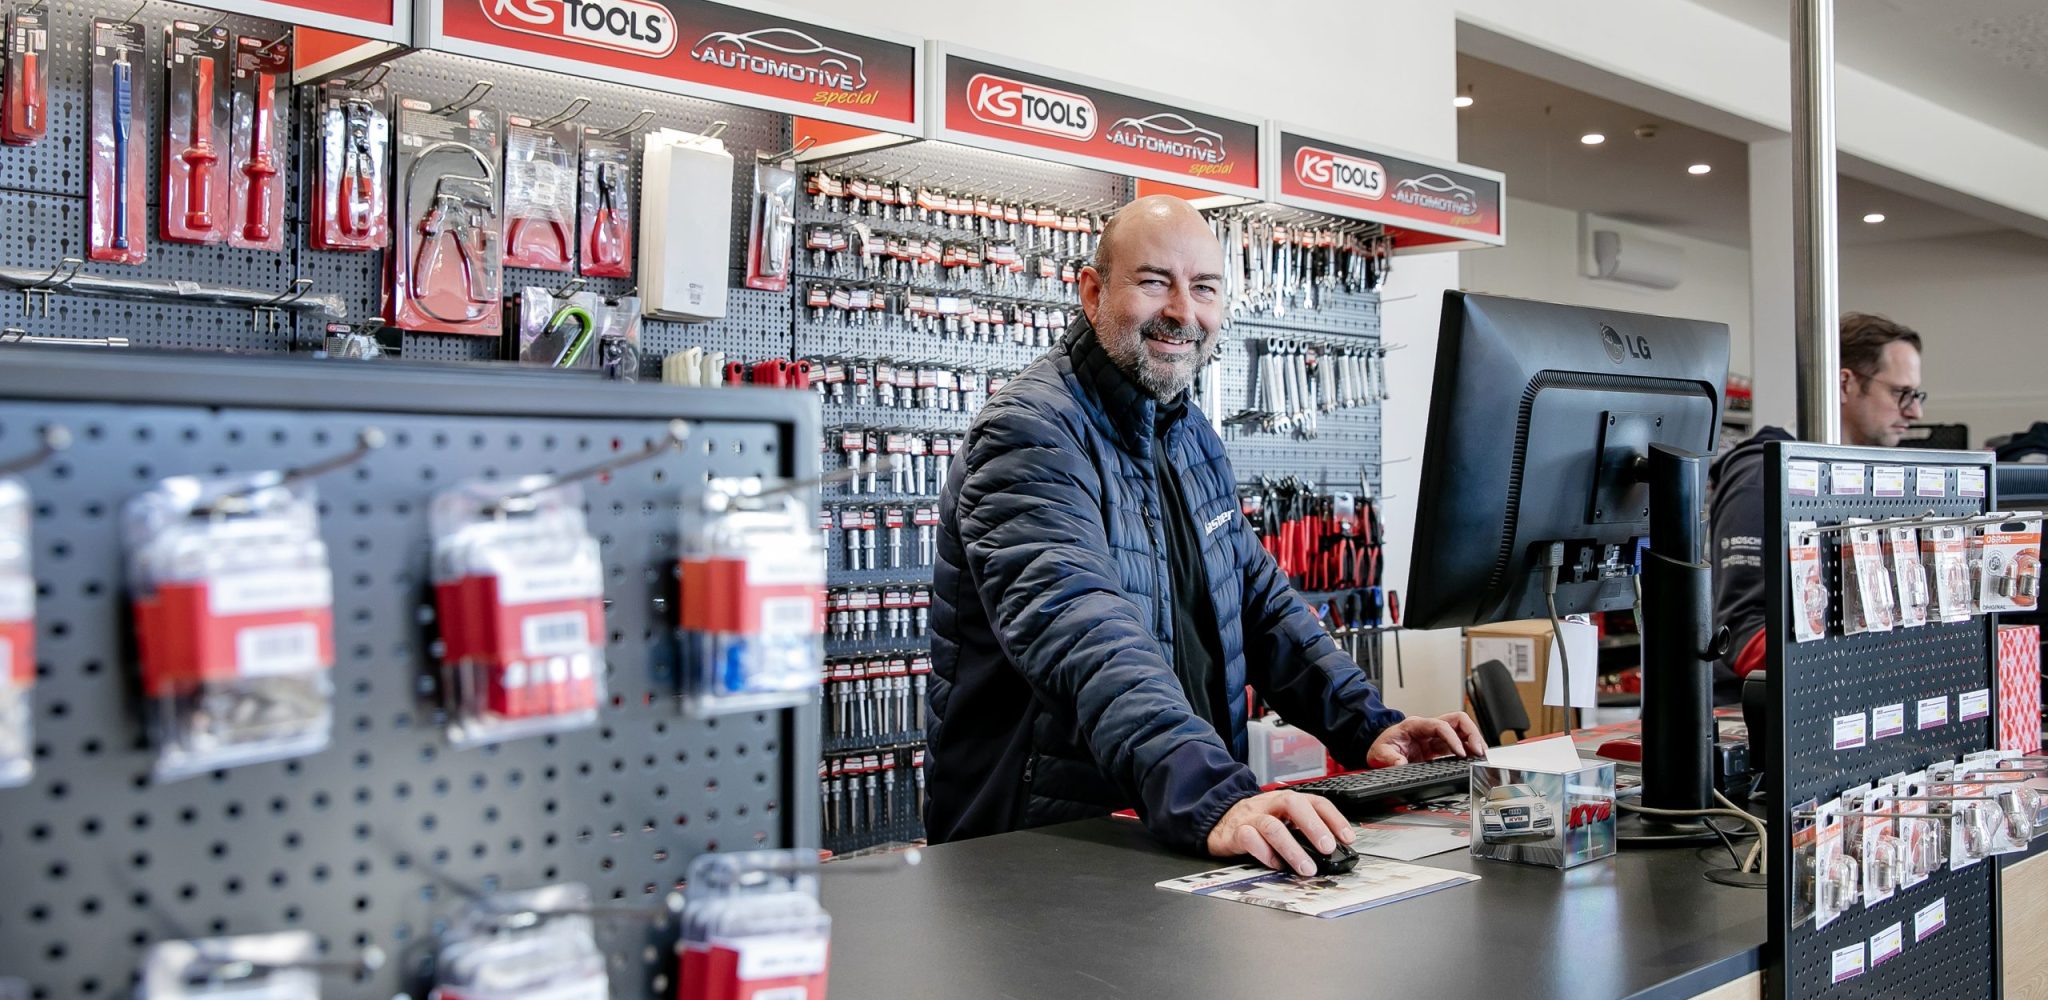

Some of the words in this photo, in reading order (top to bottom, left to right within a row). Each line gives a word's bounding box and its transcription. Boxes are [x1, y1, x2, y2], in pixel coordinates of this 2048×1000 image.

[563, 0, 662, 43] TOOLS
[700, 46, 854, 91] AUTOMOTIVE
[812, 90, 879, 106] special
[976, 83, 1022, 117] KS
[1021, 94, 1087, 130] TOOLS
[1113, 130, 1217, 163] AUTOMOTIVE
[1188, 162, 1235, 177] special
[1301, 154, 1333, 183] KS
[1332, 163, 1378, 190] TOOLS
[1396, 190, 1470, 214] AUTOMOTIVE
[1625, 335, 1652, 360] LG
[1986, 535, 2012, 544] OSRAM
